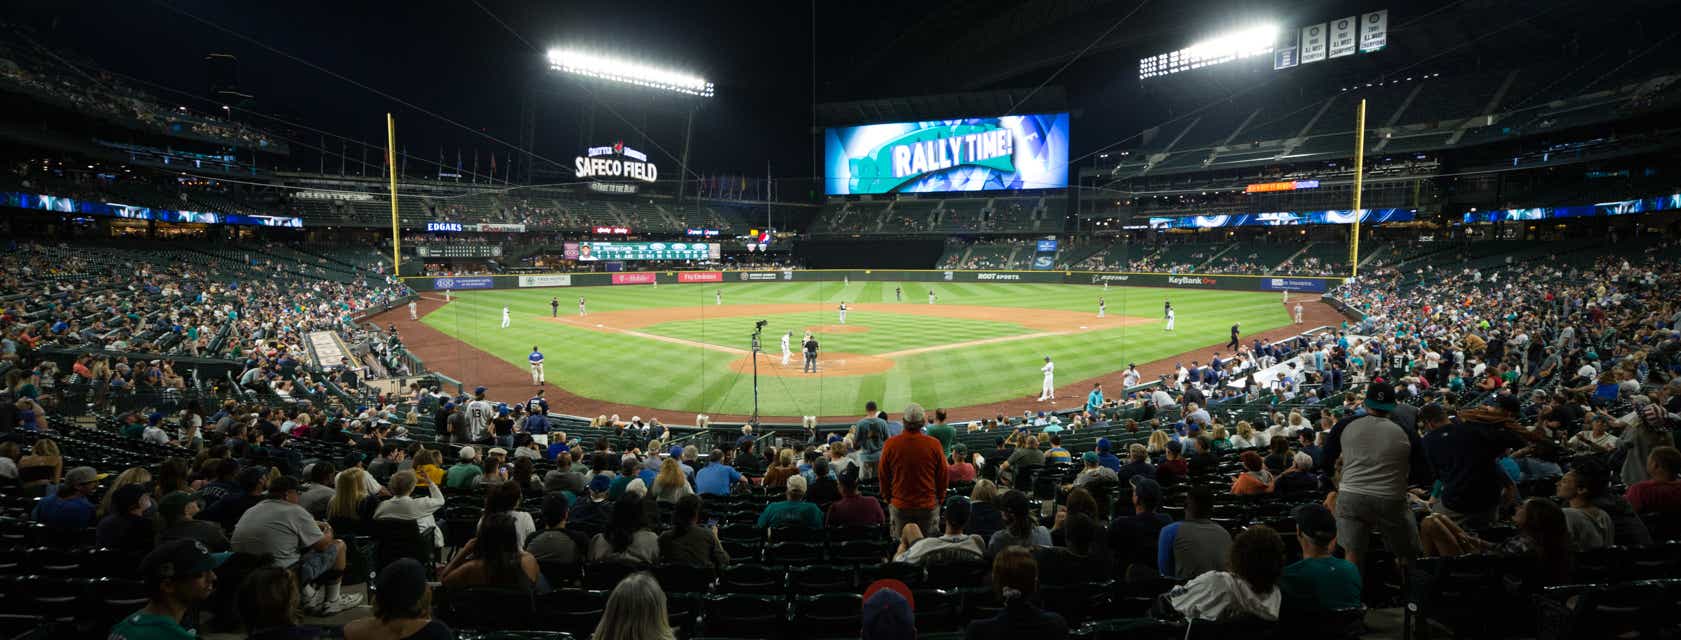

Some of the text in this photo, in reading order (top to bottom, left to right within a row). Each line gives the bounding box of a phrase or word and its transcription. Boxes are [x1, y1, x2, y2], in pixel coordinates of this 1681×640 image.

[895, 128, 1013, 178] RALLY TIME!
[575, 156, 658, 183] SAFECO FIELD
[1168, 276, 1202, 285] KeyBank
[471, 408, 481, 418] 13
